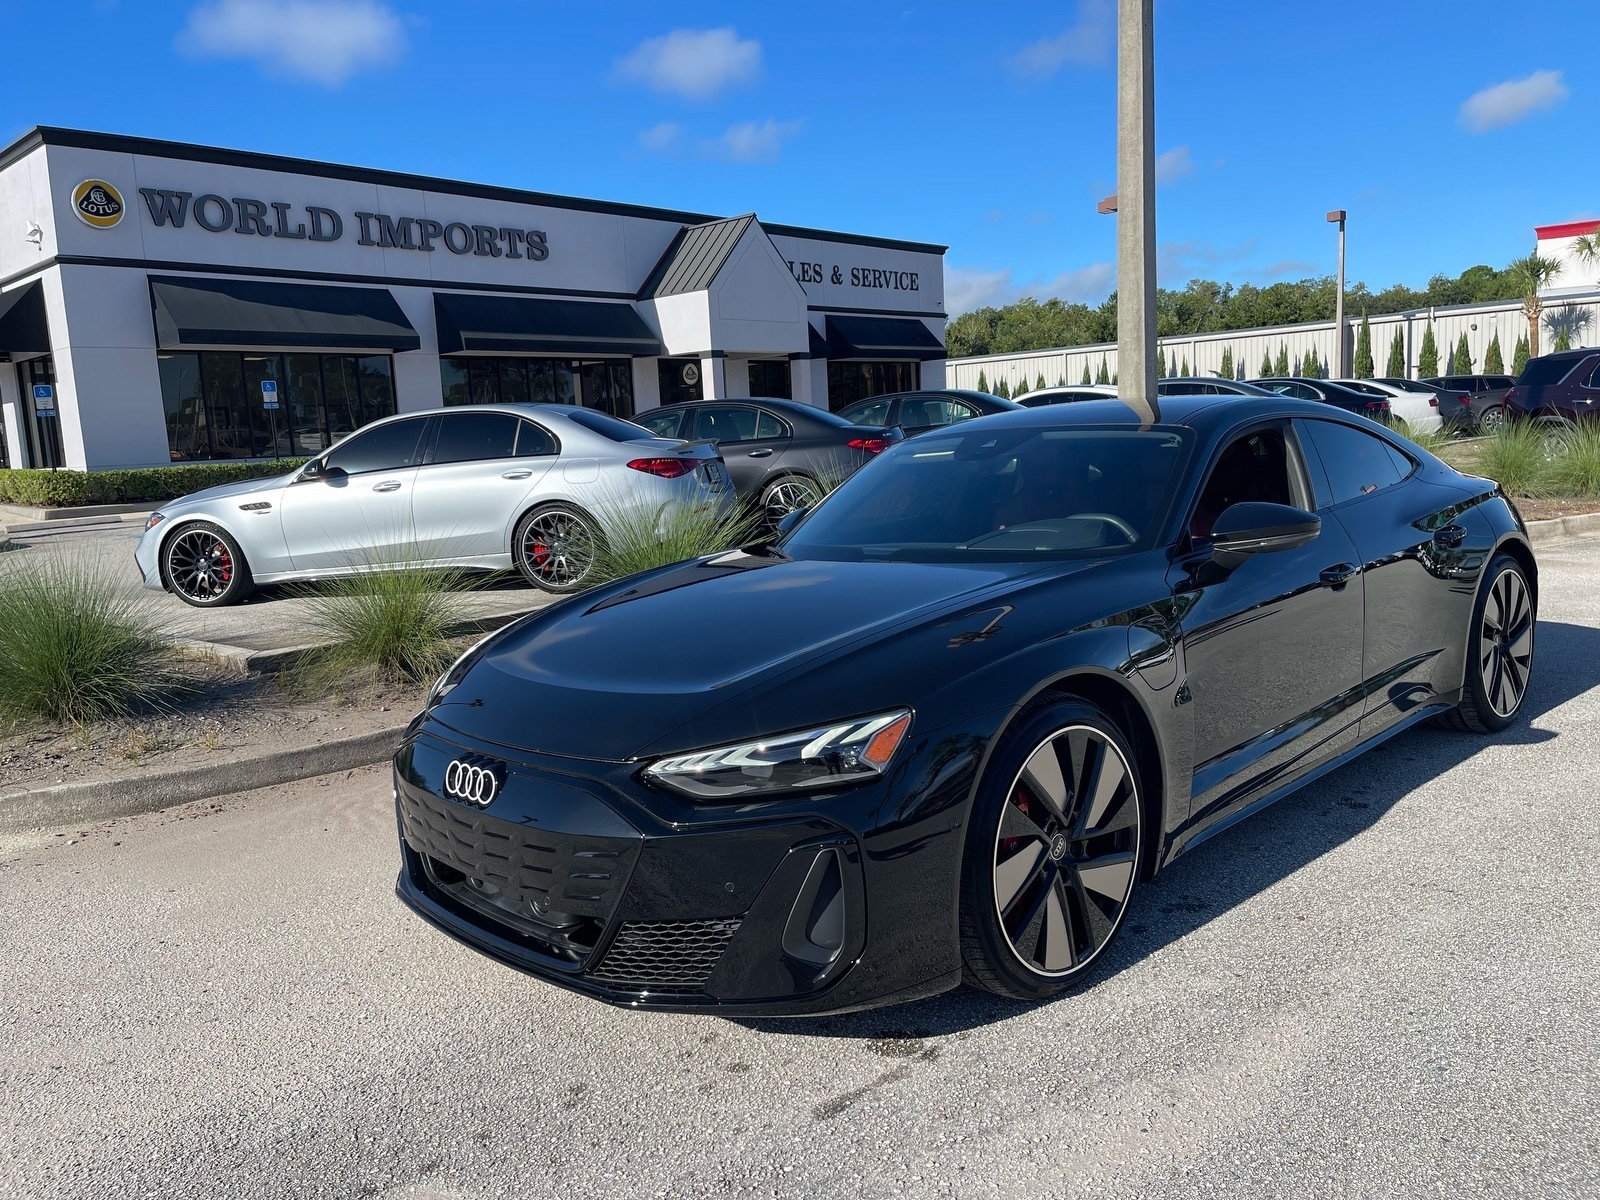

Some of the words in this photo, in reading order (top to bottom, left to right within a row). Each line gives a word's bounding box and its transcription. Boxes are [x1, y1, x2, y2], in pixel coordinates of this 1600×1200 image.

[81, 200, 120, 214] LOTUS
[138, 187, 344, 242] WORLD
[354, 211, 550, 262] IMPORTS
[830, 264, 844, 286] &
[850, 266, 920, 292] SERVICE
